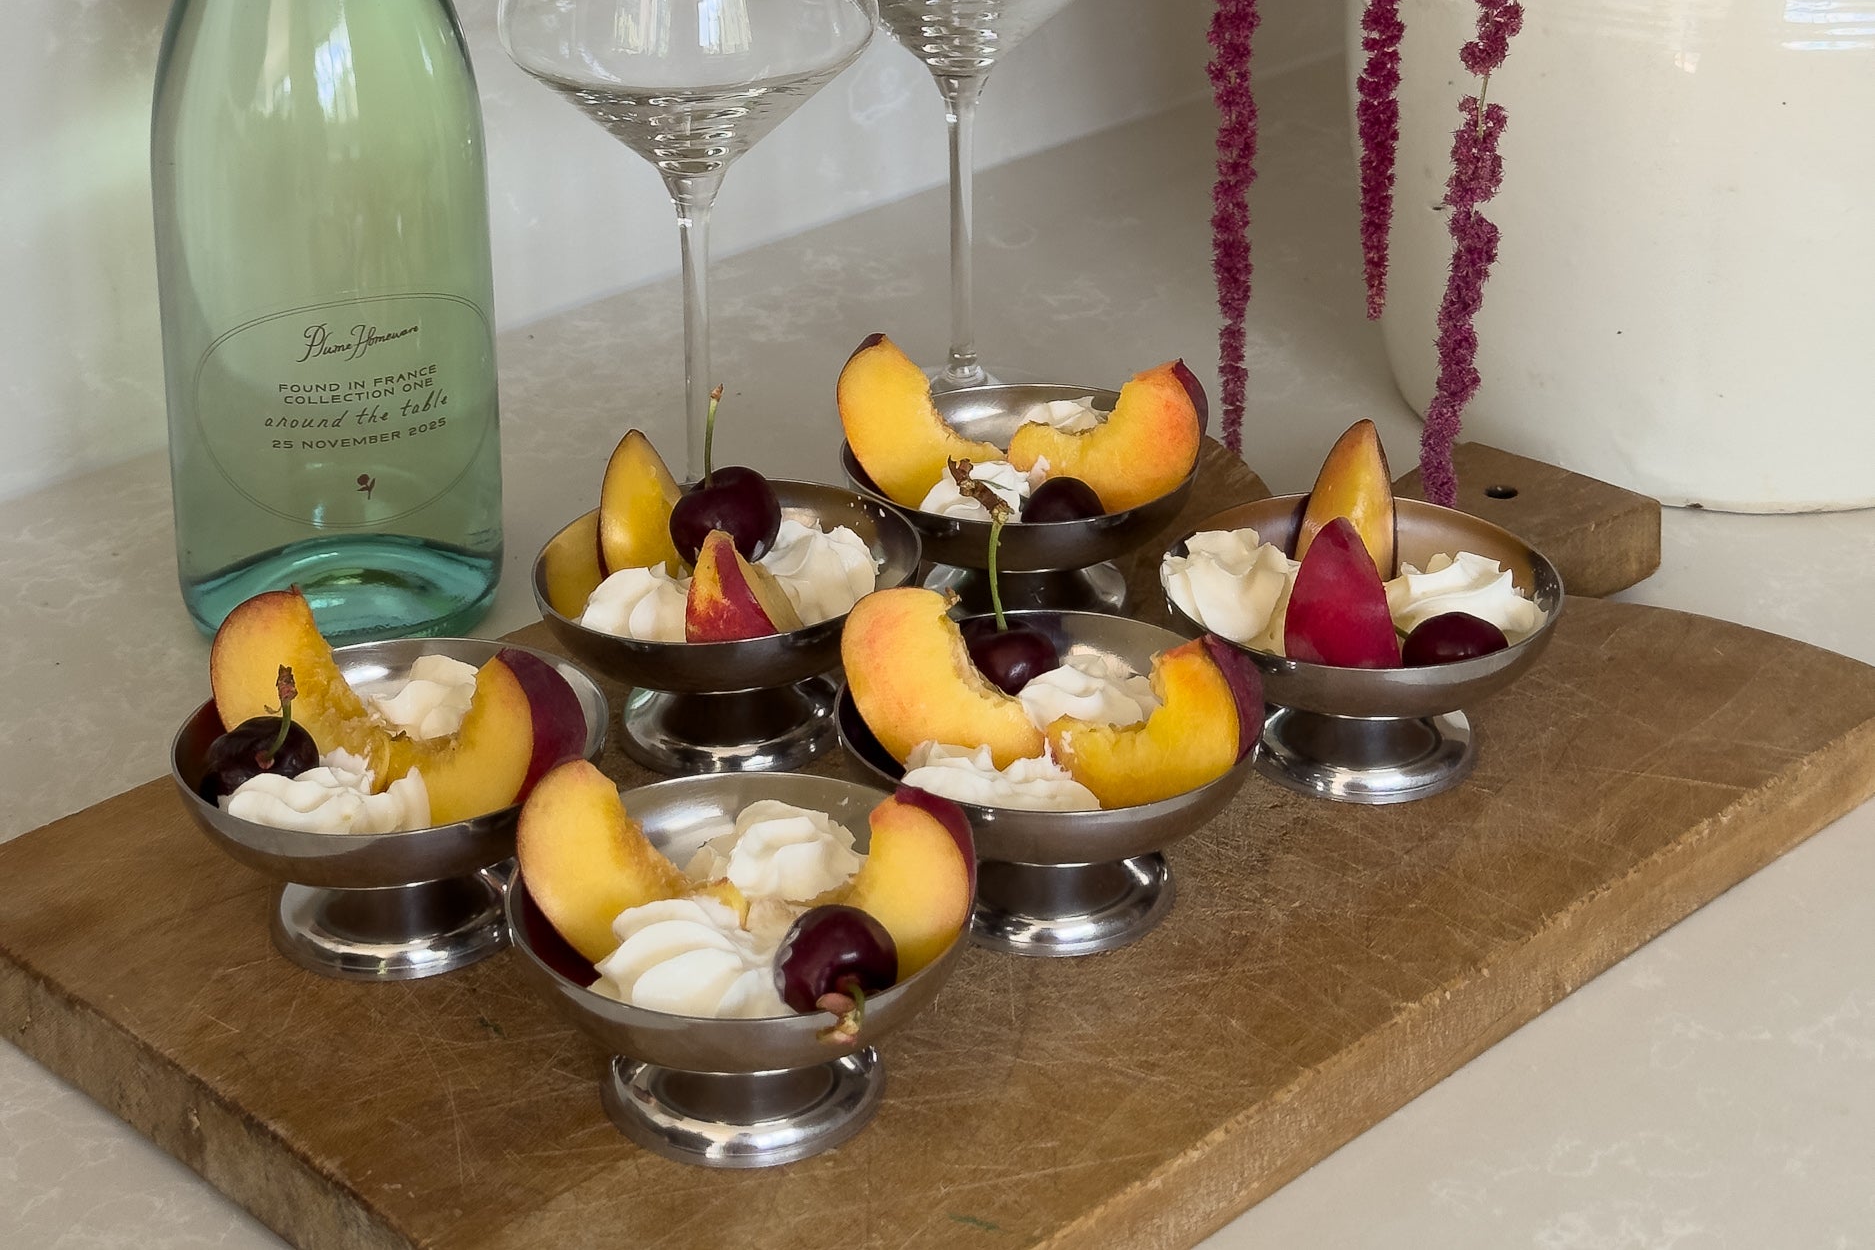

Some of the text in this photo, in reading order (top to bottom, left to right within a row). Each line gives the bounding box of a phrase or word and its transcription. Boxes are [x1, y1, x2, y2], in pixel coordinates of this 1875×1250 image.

[297, 323, 352, 362] Plume
[278, 364, 437, 393] FOUND IN FRANCE
[284, 377, 434, 405] COLLECTION ONE
[264, 388, 449, 429] around the table
[272, 417, 447, 450] 25 NOVEMBER 2025
